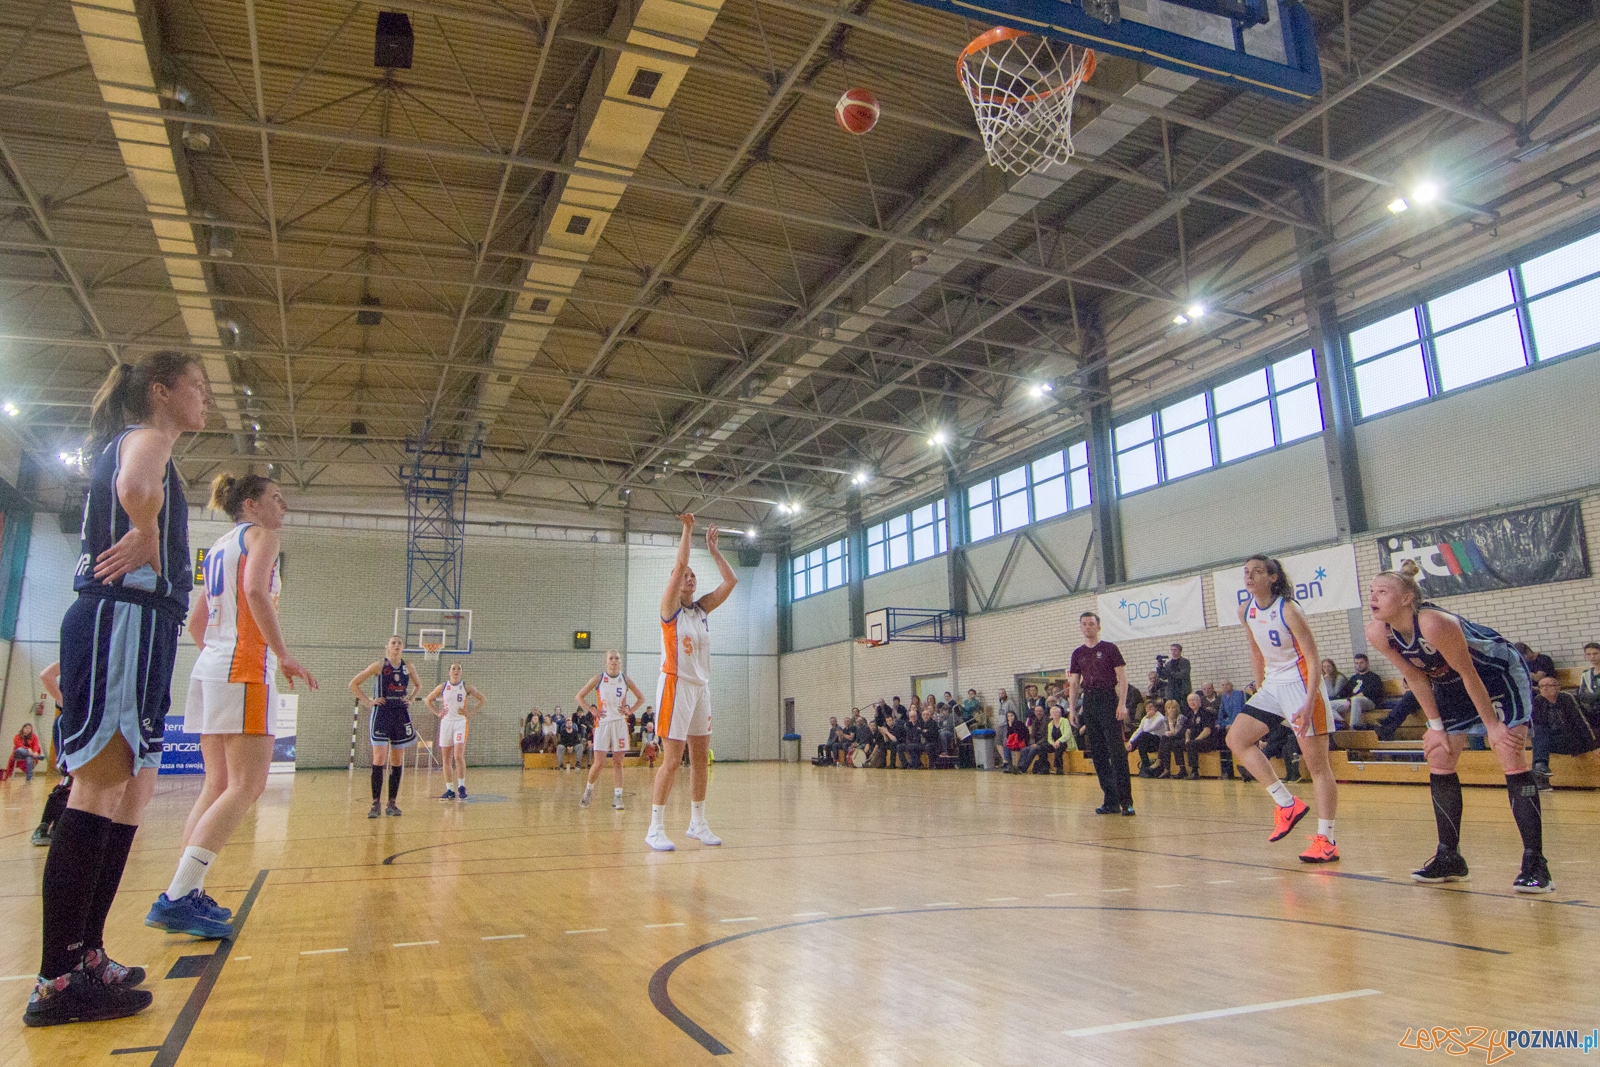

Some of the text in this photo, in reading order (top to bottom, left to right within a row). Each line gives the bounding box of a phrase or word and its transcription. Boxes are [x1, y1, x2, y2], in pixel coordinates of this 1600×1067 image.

[203, 548, 225, 600] 10
[1268, 629, 1282, 647] 9
[1418, 637, 1437, 655] 6
[402, 664, 409, 675] 5
[456, 693, 463, 702] 6
[616, 687, 623, 698] 5
[1491, 701, 1505, 722] 6
[405, 724, 413, 736] 5
[456, 733, 462, 741] 6
[618, 738, 626, 749] 5
